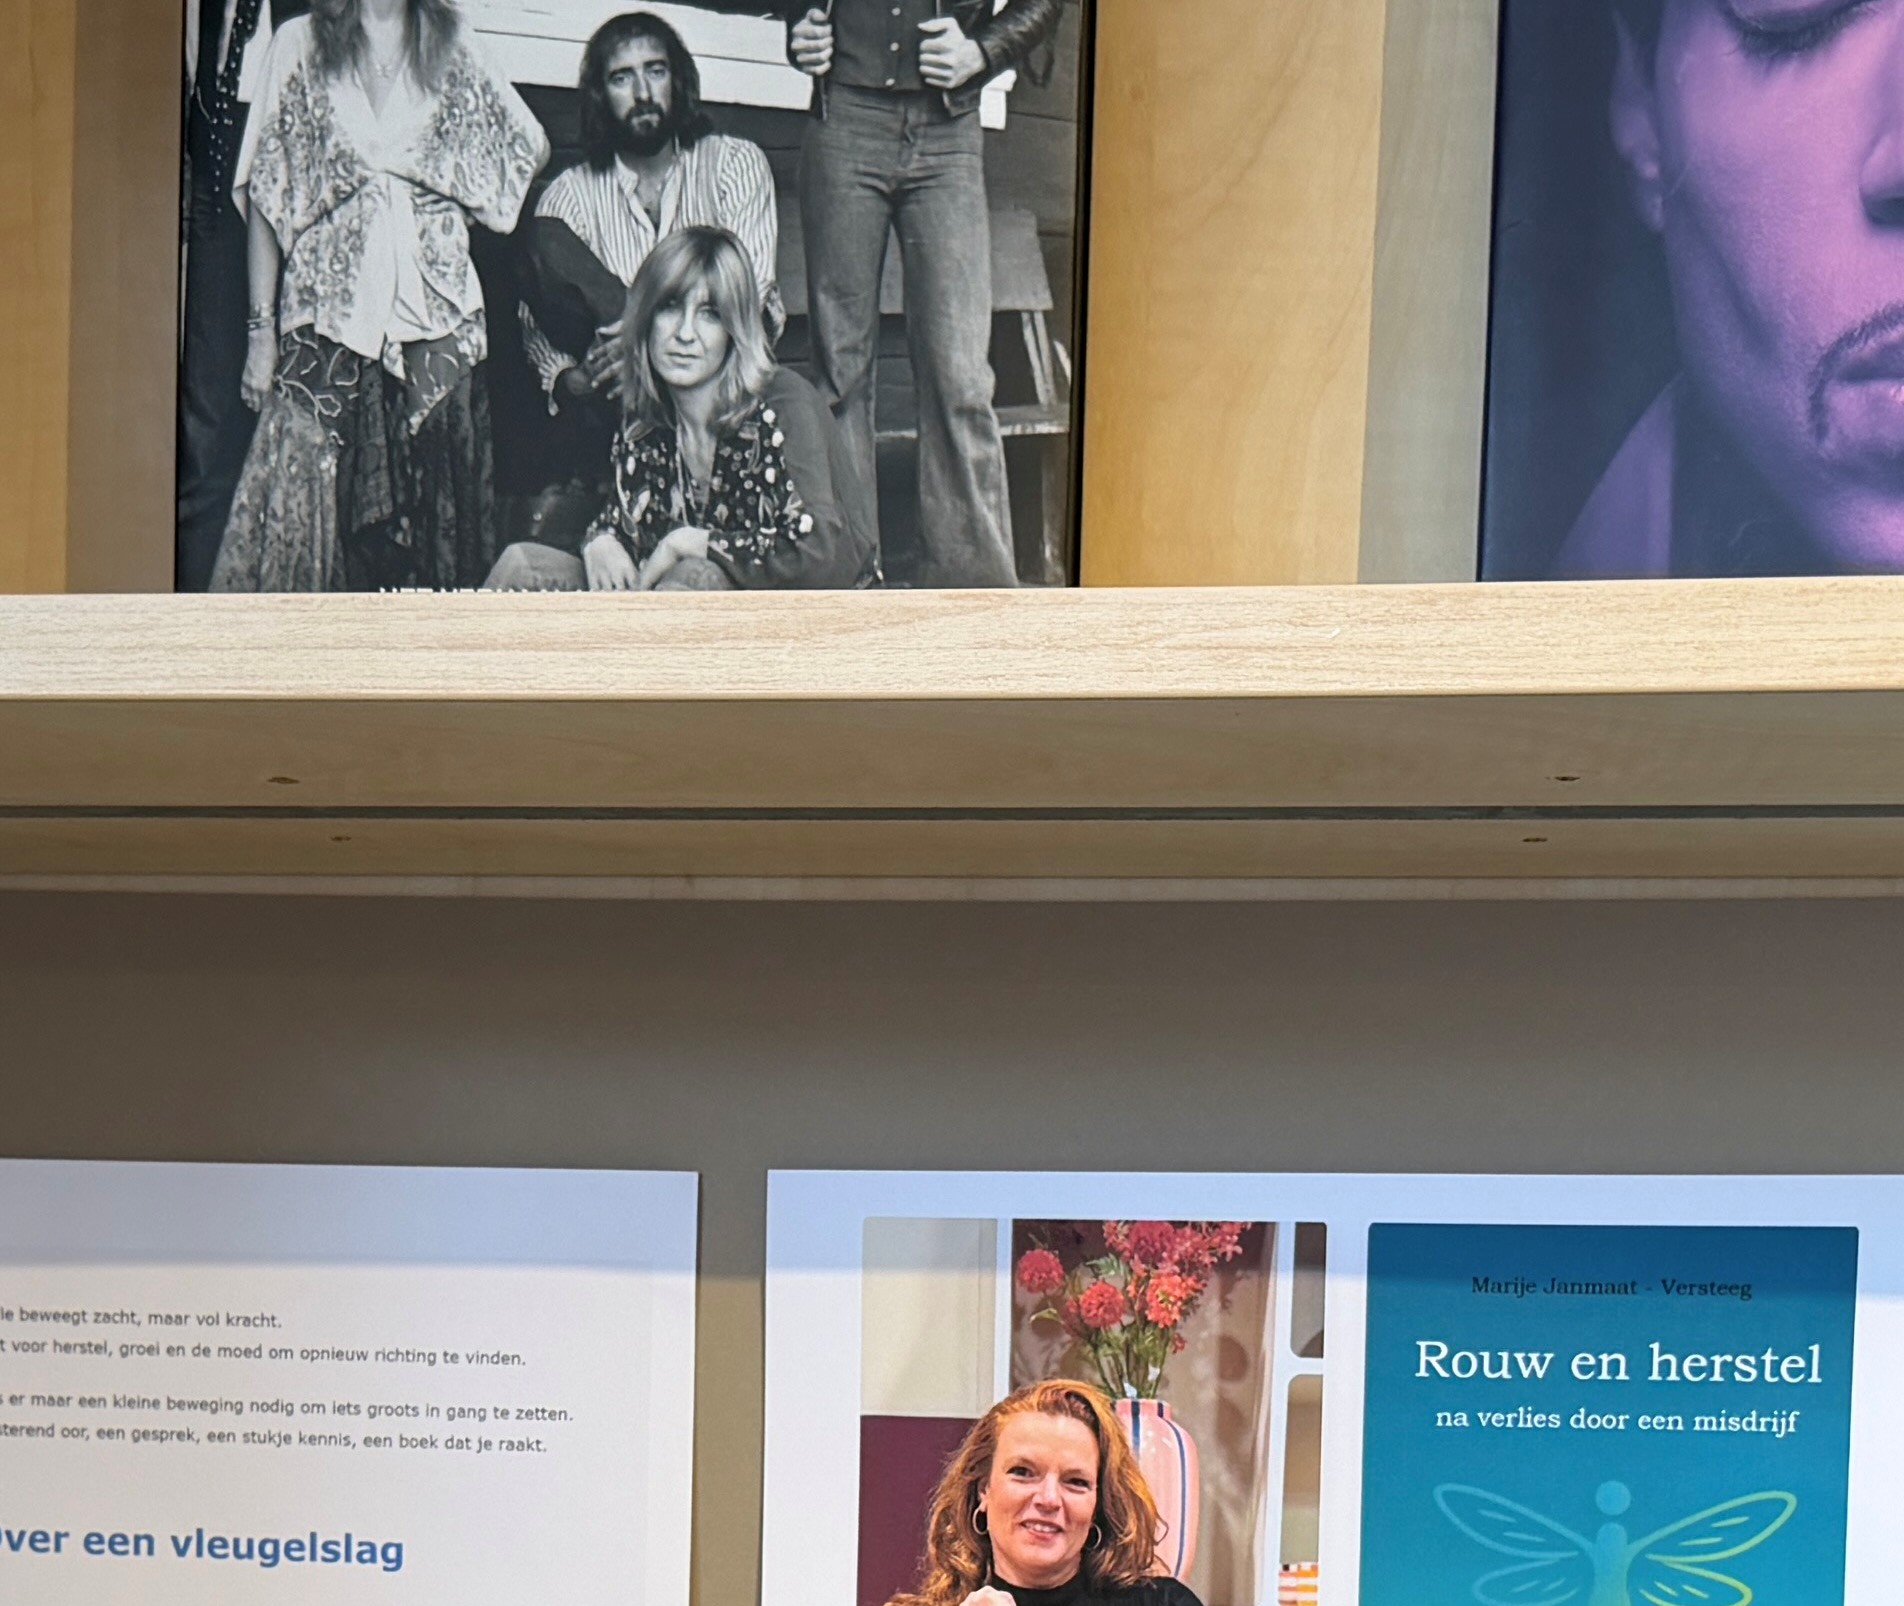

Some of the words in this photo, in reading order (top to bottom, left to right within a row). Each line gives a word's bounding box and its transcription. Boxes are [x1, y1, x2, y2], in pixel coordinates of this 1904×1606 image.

[1472, 1274, 1537, 1298] Marije
[1541, 1275, 1638, 1295] Janmaat
[1661, 1278, 1752, 1300] Versteeg
[18, 1306, 89, 1327] beweegt
[92, 1308, 142, 1328] zacht,
[147, 1313, 192, 1326] maar
[195, 1311, 221, 1327] vol
[225, 1310, 282, 1329] kracht.
[1415, 1341, 1554, 1378] Rouw
[1571, 1353, 1629, 1380] en
[1648, 1342, 1822, 1383] herstel
[1436, 1412, 1469, 1426] na
[1477, 1406, 1560, 1428] verlies
[1570, 1408, 1630, 1429] door
[1638, 1415, 1684, 1430] een
[1693, 1410, 1800, 1438] misdrijf
[84, 1532, 154, 1556] een
[171, 1528, 403, 1572] vleugelslag
